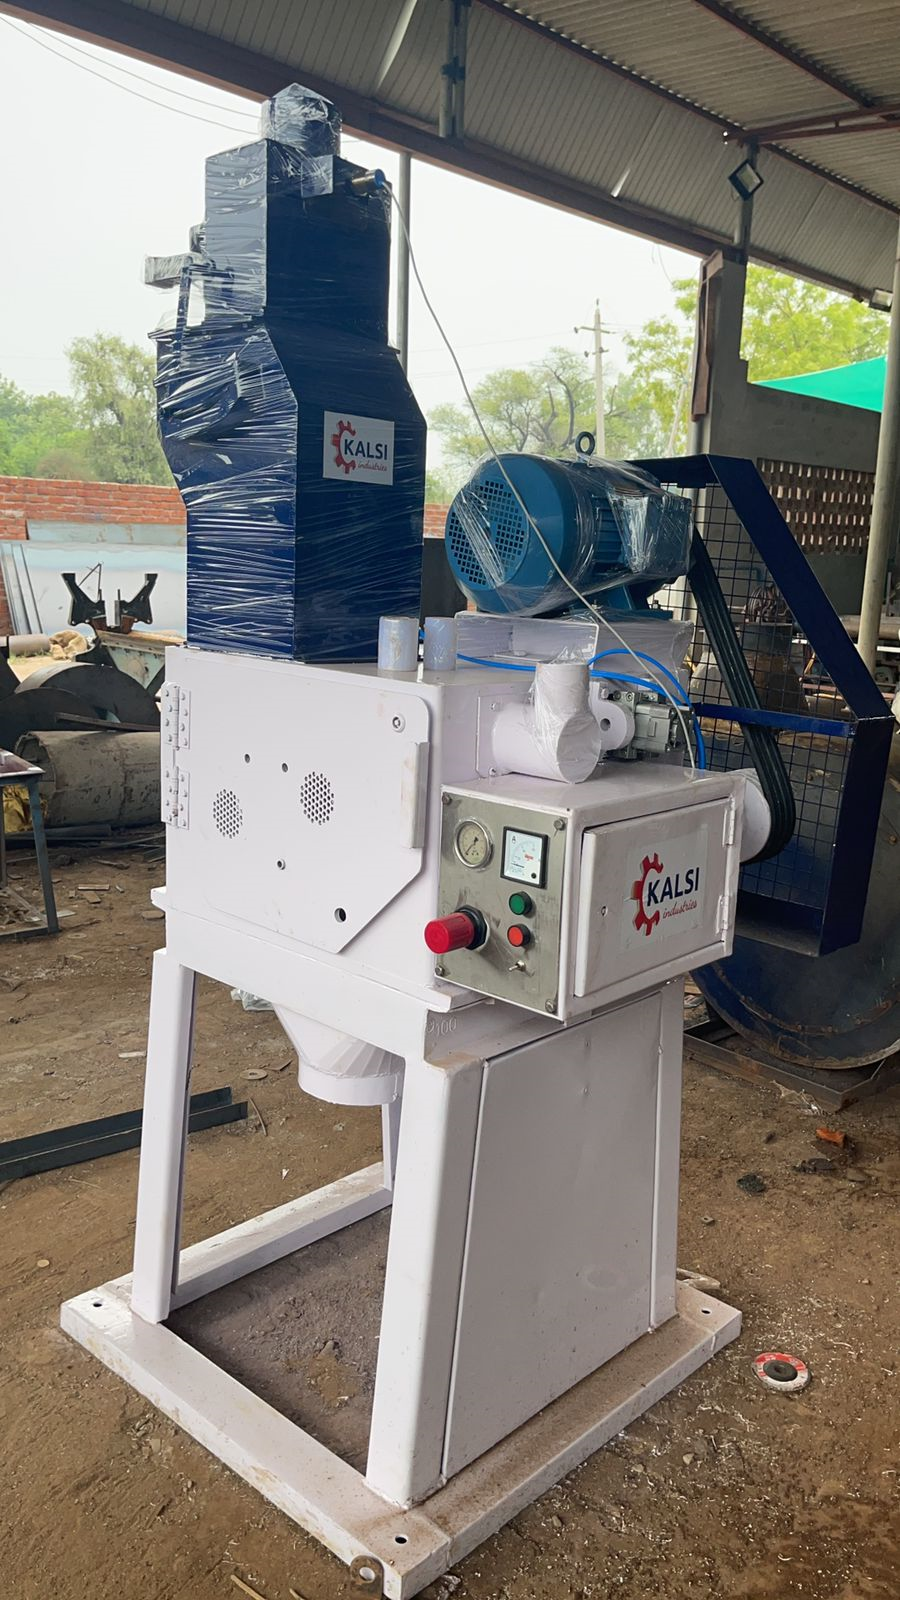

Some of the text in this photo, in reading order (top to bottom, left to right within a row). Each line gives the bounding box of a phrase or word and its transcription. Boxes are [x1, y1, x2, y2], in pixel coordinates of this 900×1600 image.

[344, 438, 388, 461] KALSI
[647, 867, 700, 907] KALSI
[662, 900, 698, 919] industries
